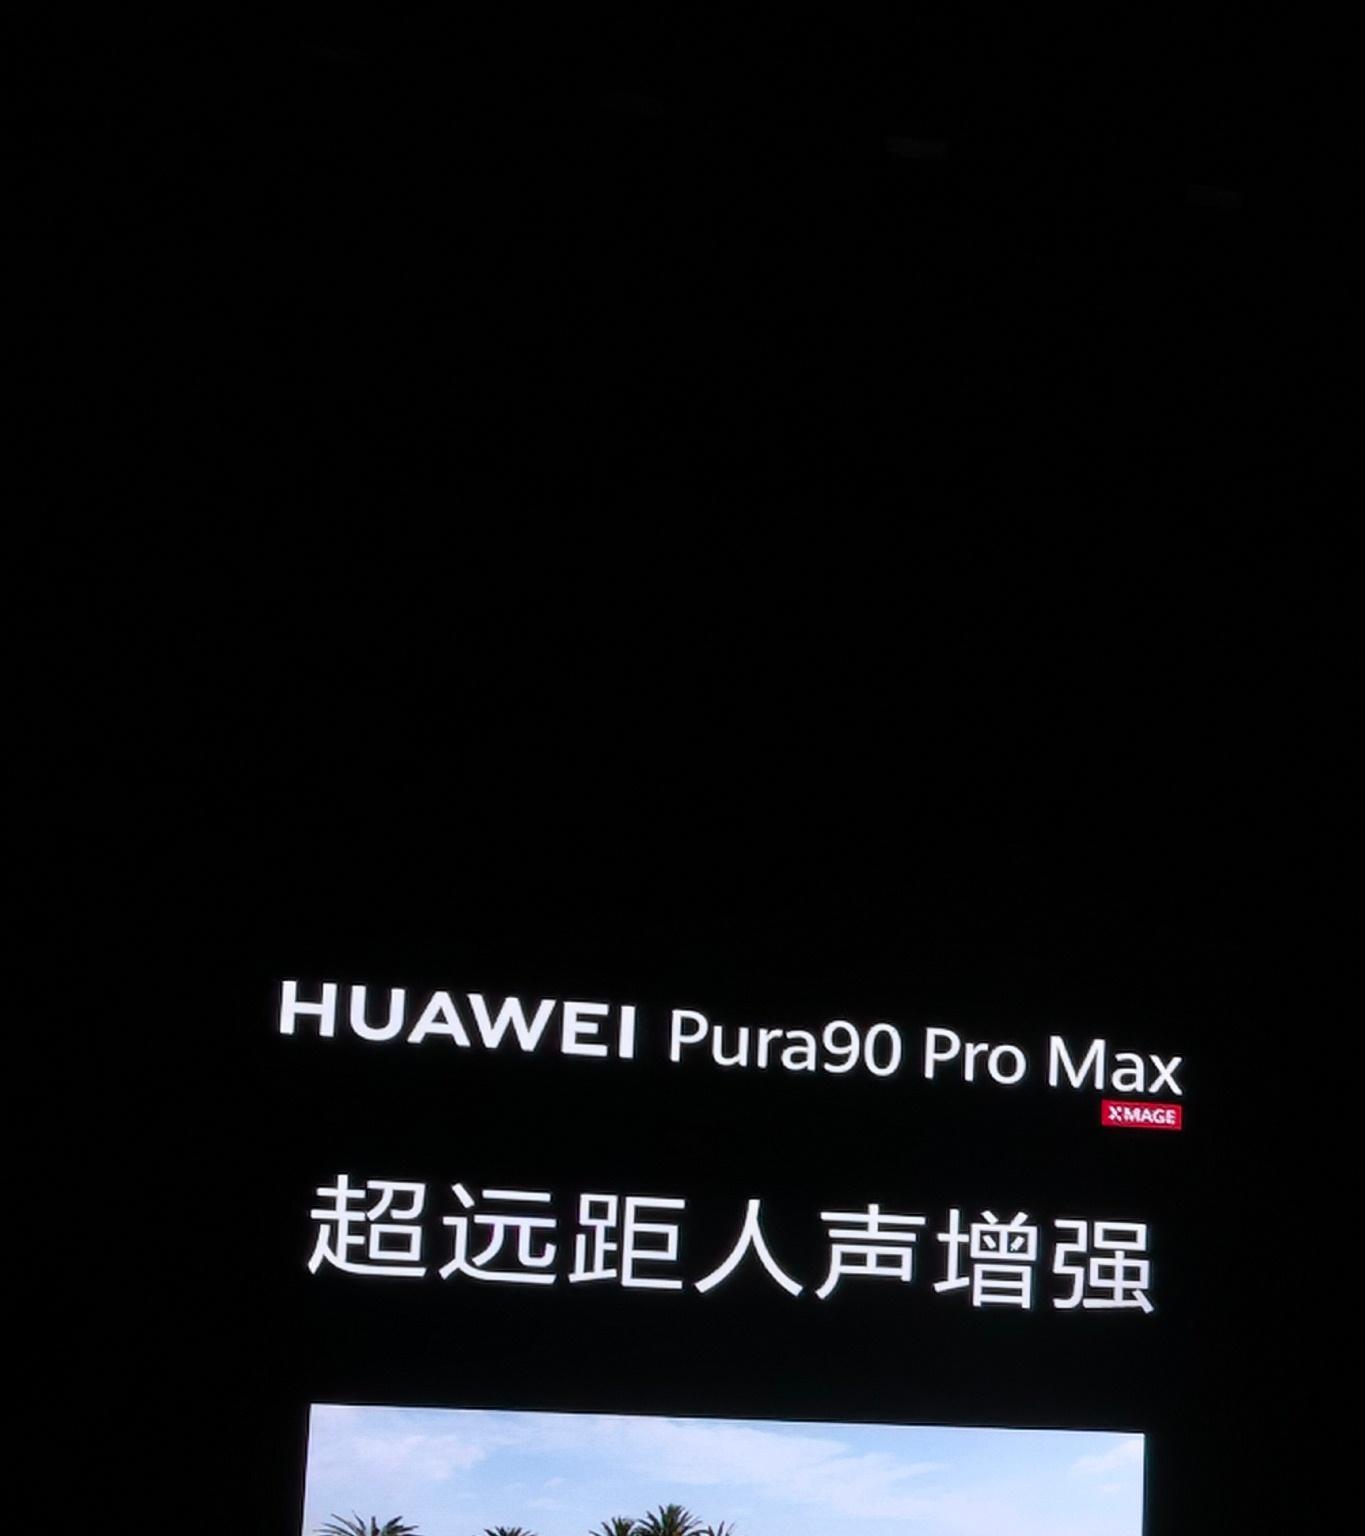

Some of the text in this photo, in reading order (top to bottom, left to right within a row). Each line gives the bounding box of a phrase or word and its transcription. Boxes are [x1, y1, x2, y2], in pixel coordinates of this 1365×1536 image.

[279, 980, 1183, 1096] HUAWEI Pura90 Pro Max
[1107, 1105, 1176, 1125] XMAGE
[307, 1173, 1155, 1314] 超远距人声增强
